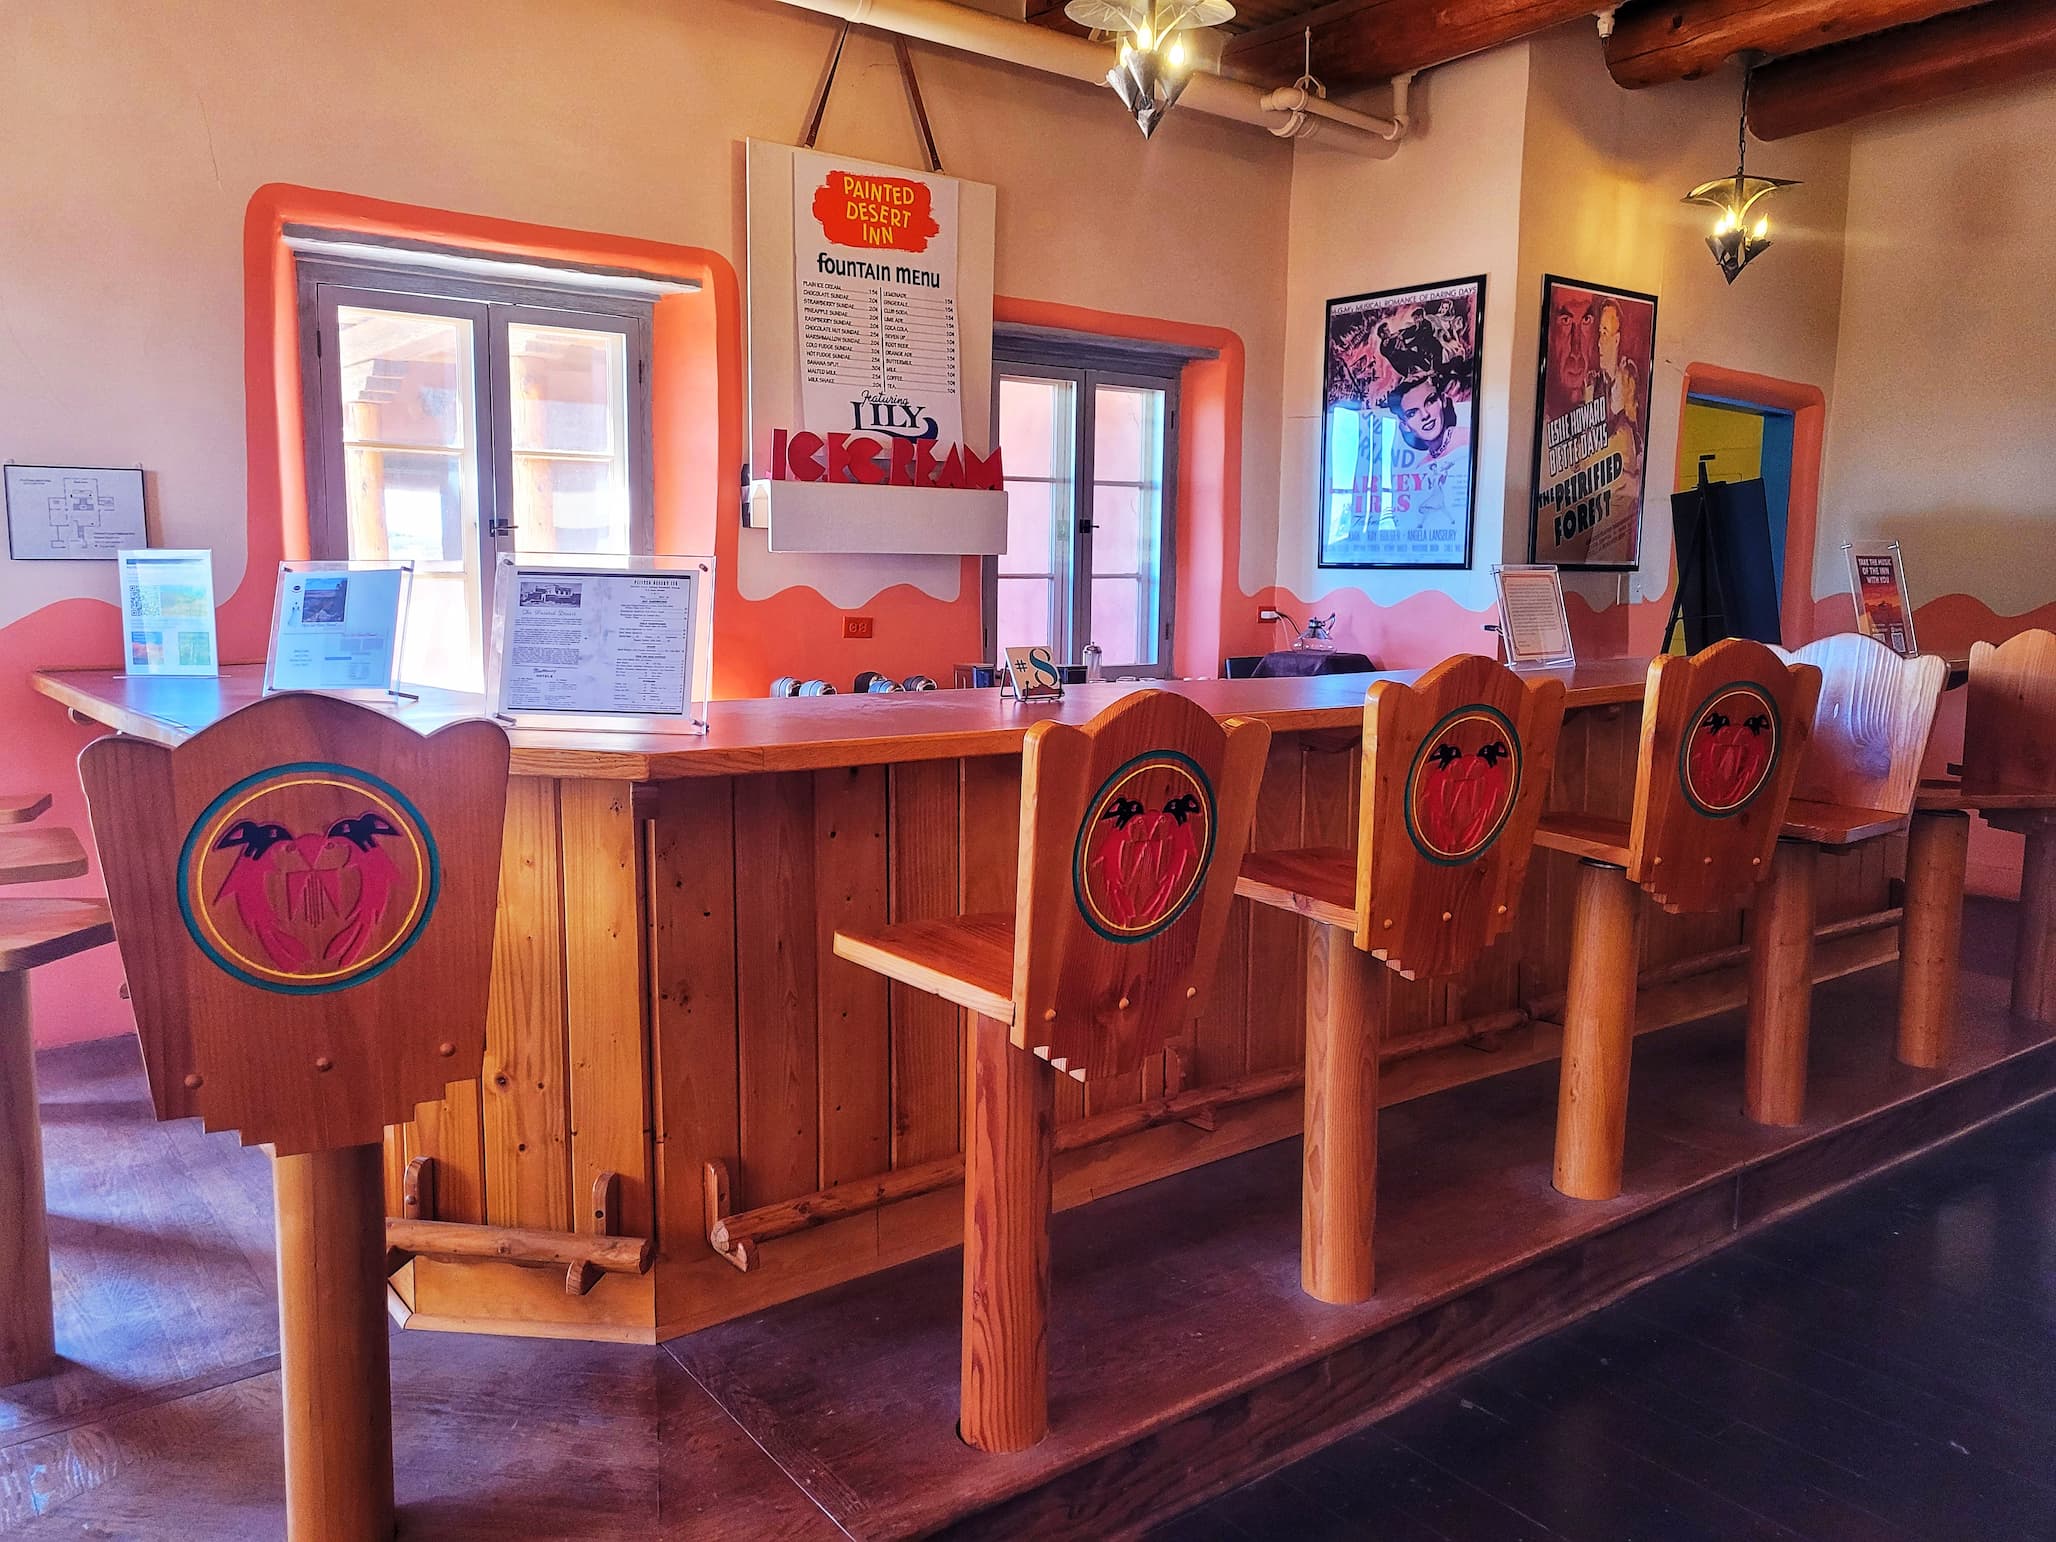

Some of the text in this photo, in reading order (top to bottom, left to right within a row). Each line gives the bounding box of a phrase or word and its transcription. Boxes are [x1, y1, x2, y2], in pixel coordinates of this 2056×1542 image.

[843, 175, 915, 206] PAINTED
[845, 200, 912, 229] DESERT
[862, 223, 894, 246] INN
[803, 290, 829, 298] CHOCOLATE
[804, 299, 835, 307] STRAWBERRY
[1384, 296, 1416, 306] ROMANCE
[1430, 288, 1457, 298] DARING
[1458, 285, 1477, 295] DAYS
[805, 334, 841, 342] MARSHMALLOW
[860, 389, 910, 410] Featuring
[849, 400, 926, 431] LILY
[1548, 396, 1606, 449] LESLIE HOWARD
[1549, 422, 1608, 477] BETTE DAVIS
[1539, 452, 1623, 513] THE PETRIFIED
[1554, 490, 1612, 547] FOREST
[1408, 528, 1426, 542] ANGELA
[1429, 529, 1456, 542] LANSBURY
[1862, 567, 1890, 575] OF THE INN
[1866, 576, 1890, 584] WITH YOU
